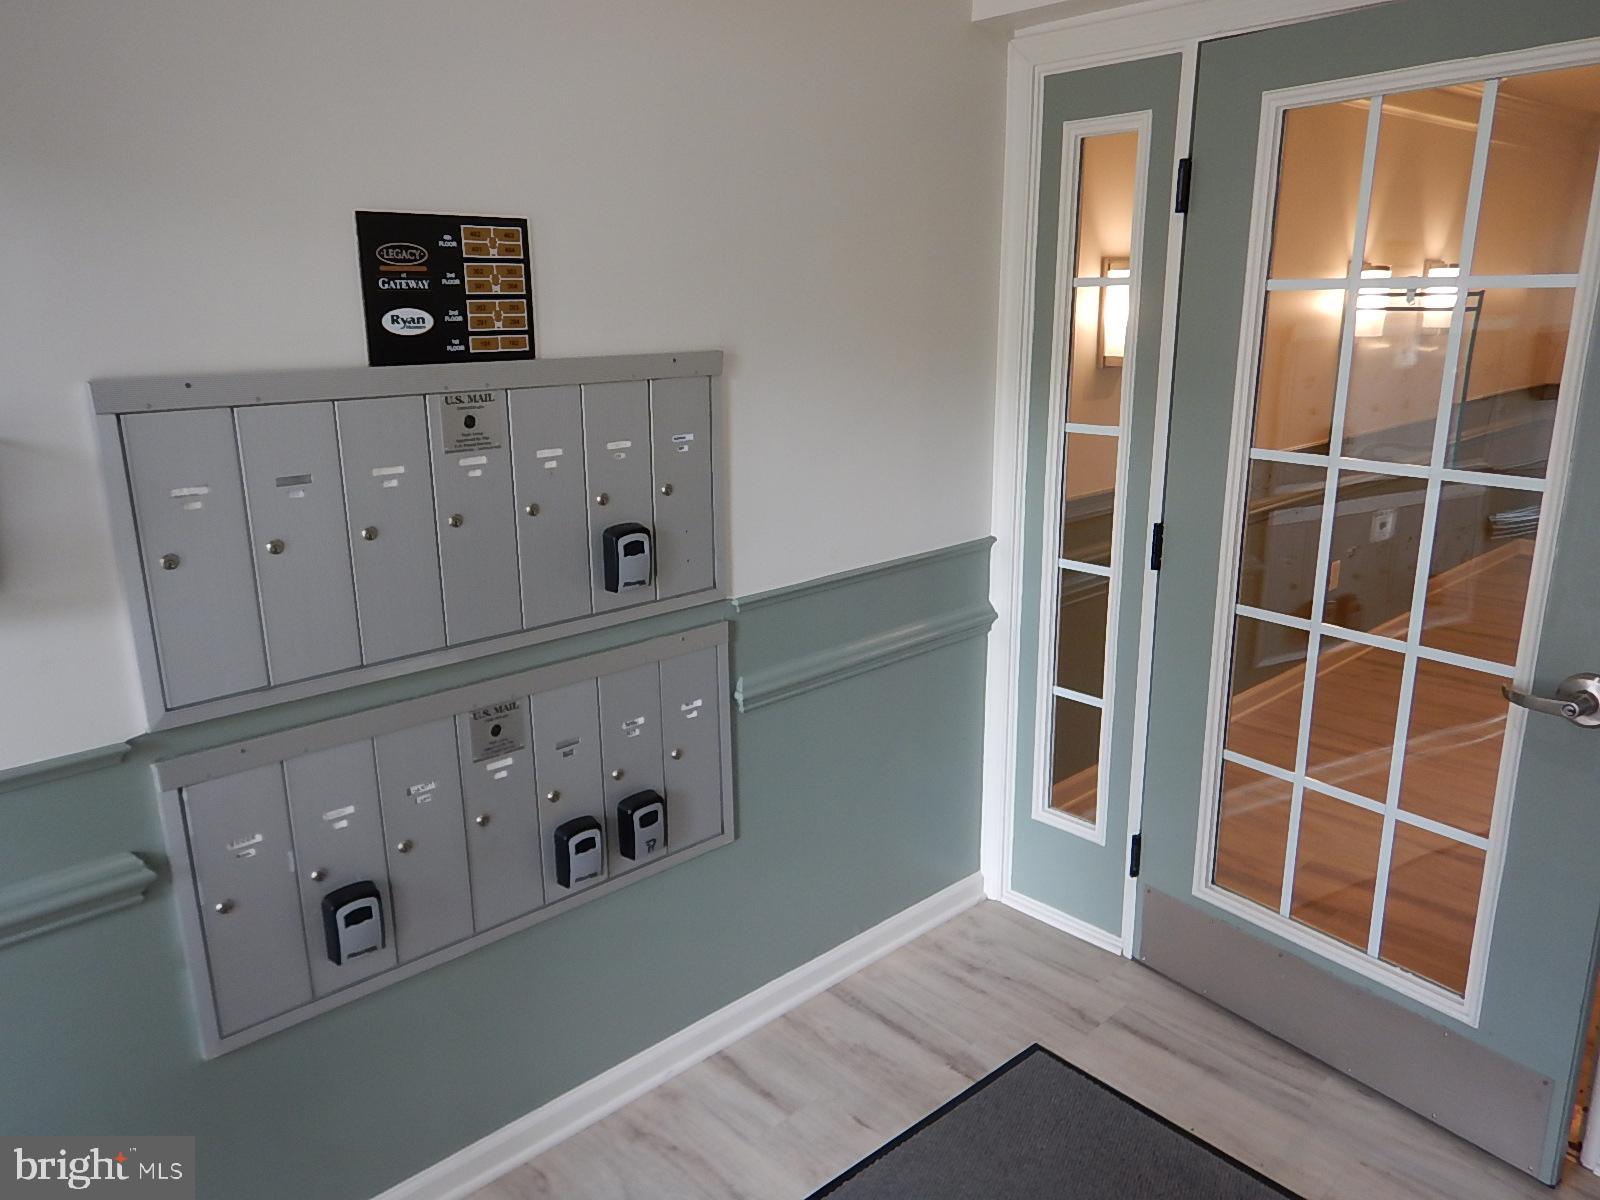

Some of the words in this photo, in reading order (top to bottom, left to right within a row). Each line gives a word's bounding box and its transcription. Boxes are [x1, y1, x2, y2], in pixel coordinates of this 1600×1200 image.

[383, 248, 421, 260] LEGACY
[378, 278, 430, 290] GATEWAY
[441, 278, 460, 286] FLOOR
[390, 314, 426, 330] Ryan
[444, 395, 465, 405] U.S.
[467, 393, 495, 403] MAIL
[494, 702, 520, 713] MAIL
